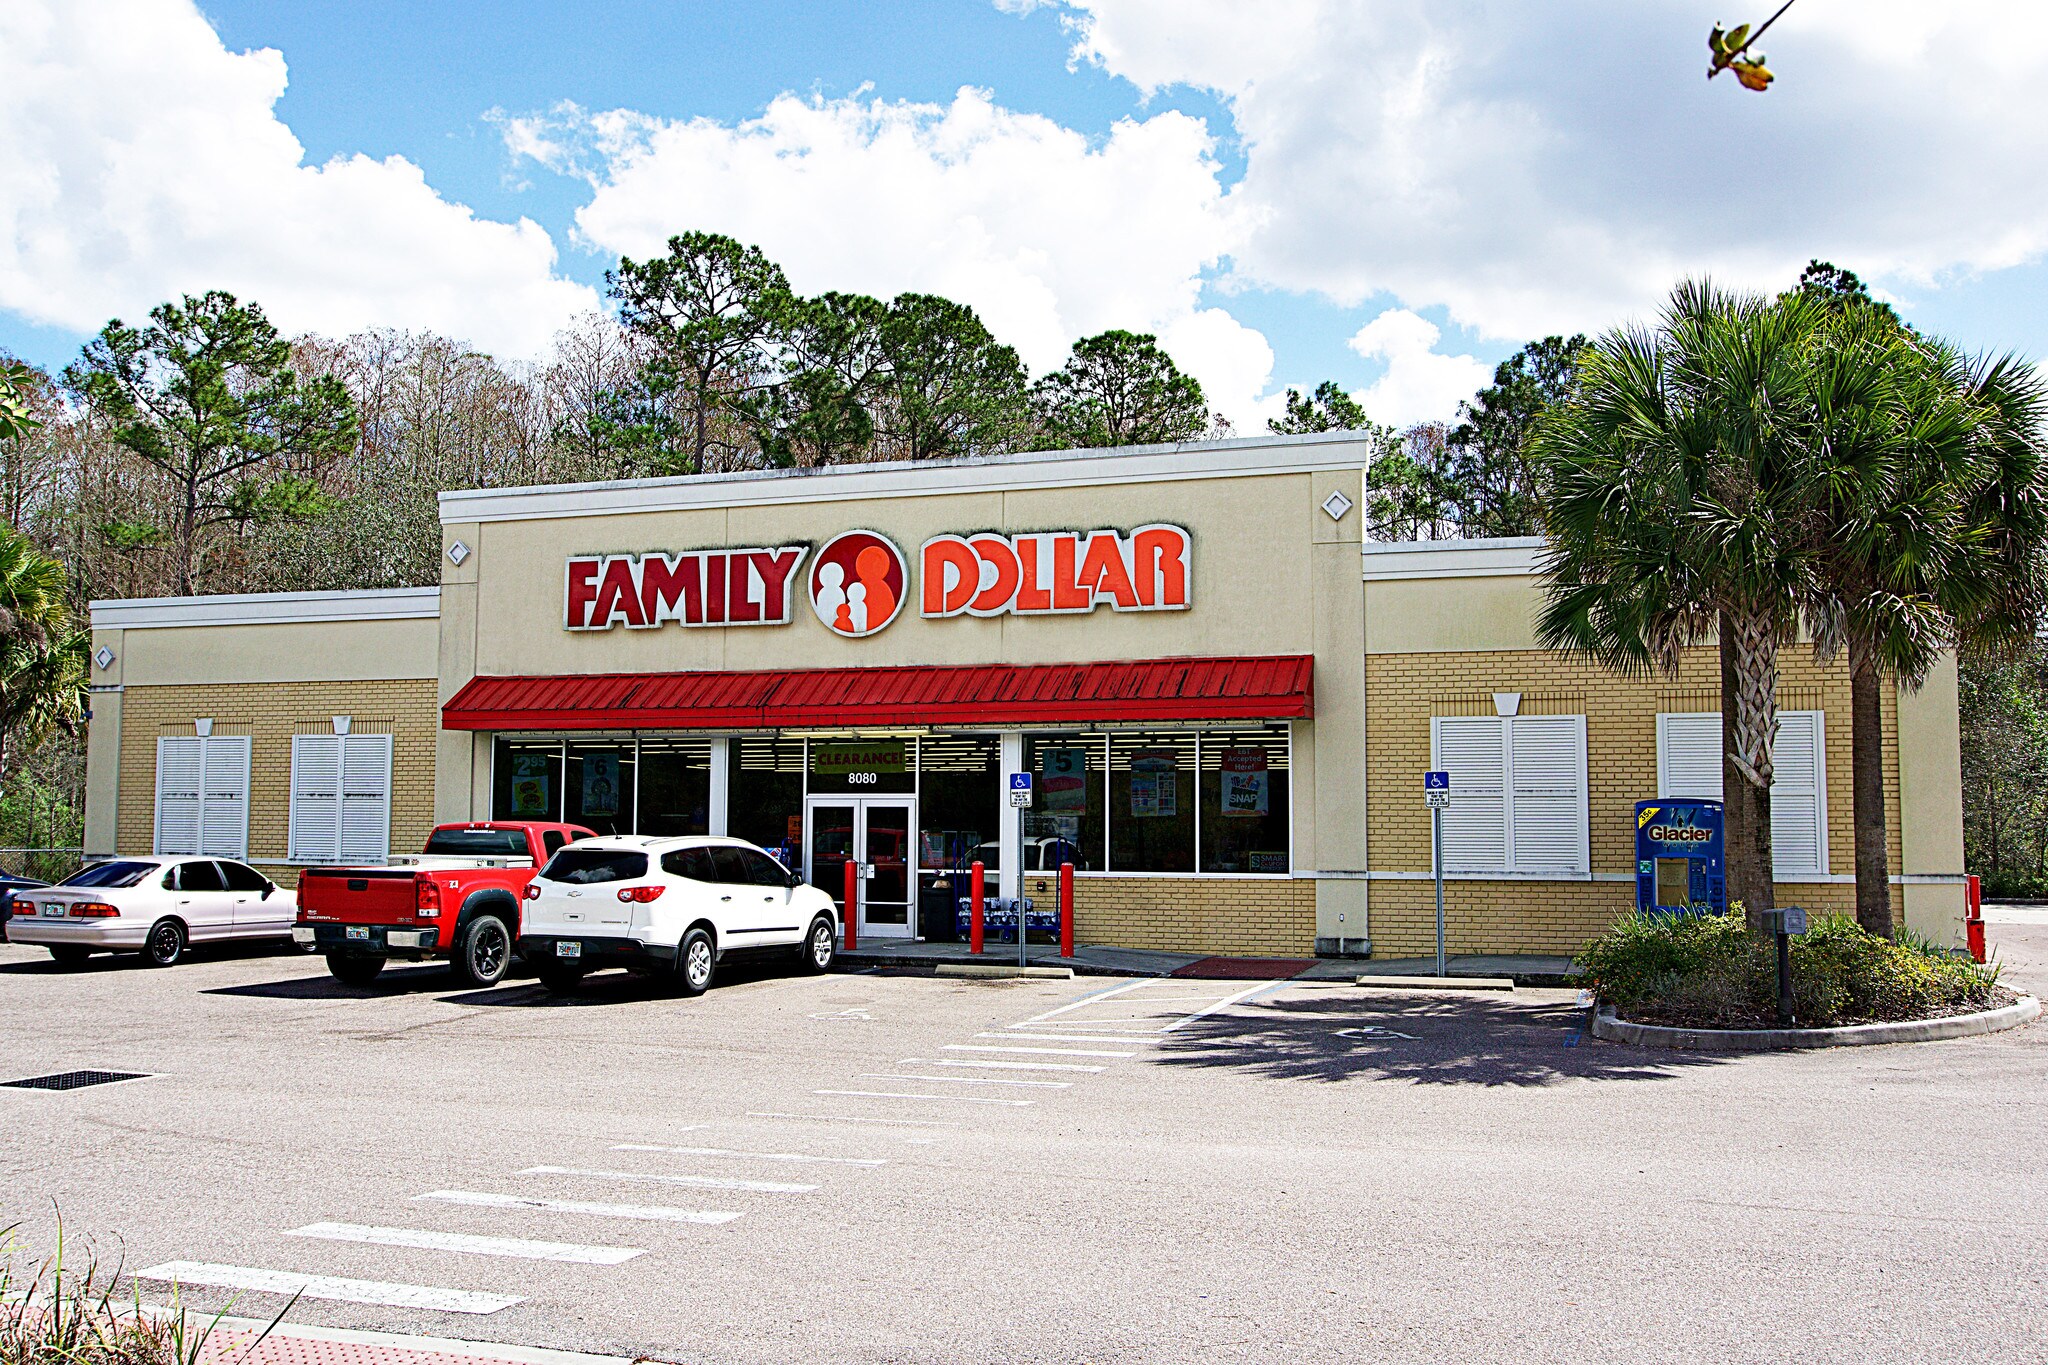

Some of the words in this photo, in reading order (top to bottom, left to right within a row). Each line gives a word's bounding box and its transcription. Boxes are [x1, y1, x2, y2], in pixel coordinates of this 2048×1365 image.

[566, 551, 801, 628] FAMILY
[923, 528, 1186, 614] DOLLAR
[818, 752, 903, 765] CLEARANCE!
[1228, 755, 1261, 763] Accepted
[848, 772, 877, 784] 8080
[1230, 794, 1257, 803] SNAP
[1648, 825, 1712, 841] Glacier
